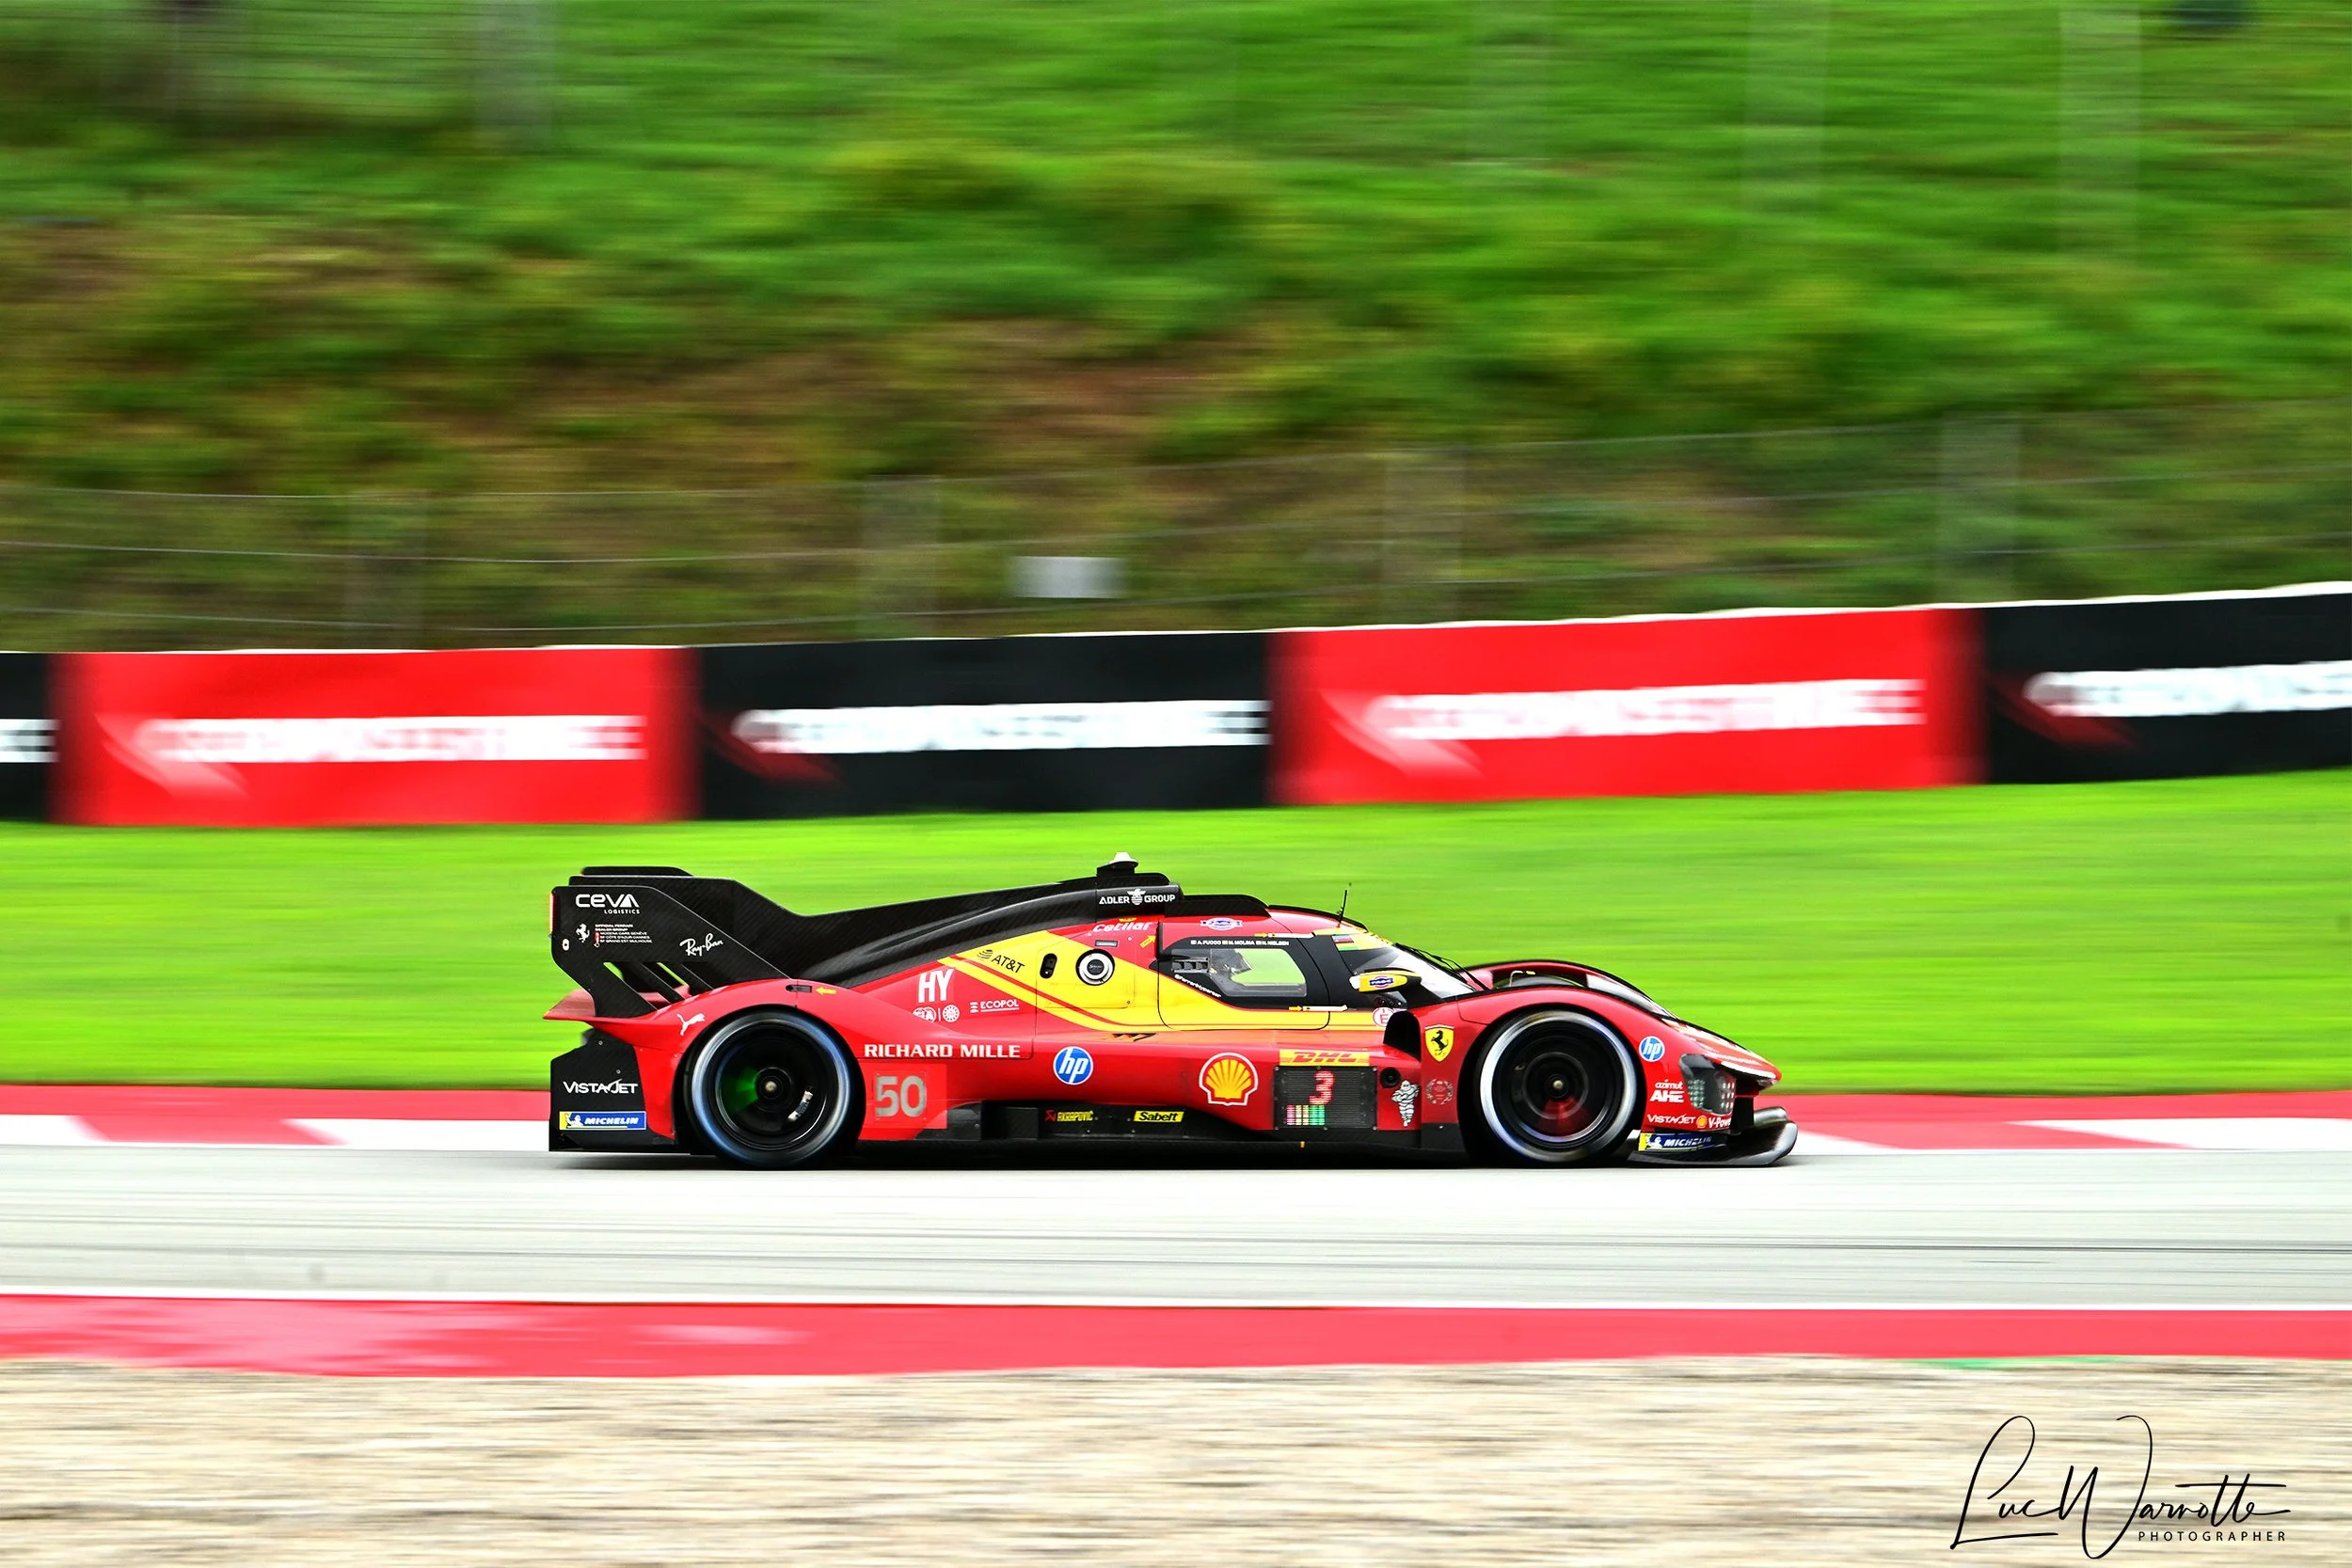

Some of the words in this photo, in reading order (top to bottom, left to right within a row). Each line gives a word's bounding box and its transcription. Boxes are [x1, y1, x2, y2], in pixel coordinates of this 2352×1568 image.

[575, 894, 640, 908] CEVA
[1099, 896, 1130, 905] ADLER
[1144, 895, 1176, 903] GROUP
[679, 932, 723, 957] Ray-Ban
[991, 954, 1025, 974] AT&T
[917, 968, 955, 1004] HY
[980, 999, 1020, 1009] ECOPOL
[864, 1044, 953, 1058] RICHARD
[960, 1044, 1021, 1058] MILLE
[1642, 1037, 1662, 1061] hp
[1293, 1052, 1357, 1063] DHL
[1058, 1048, 1089, 1084] hp
[563, 1078, 639, 1094] VISTAJET
[1309, 1070, 1334, 1105] 3
[1655, 1079, 1684, 1089] azimut
[875, 1075, 928, 1117] 50
[1649, 1090, 1685, 1103] AHE
[1138, 1112, 1178, 1121] Sabelt
[1663, 1136, 1712, 1148] MICHELIN
